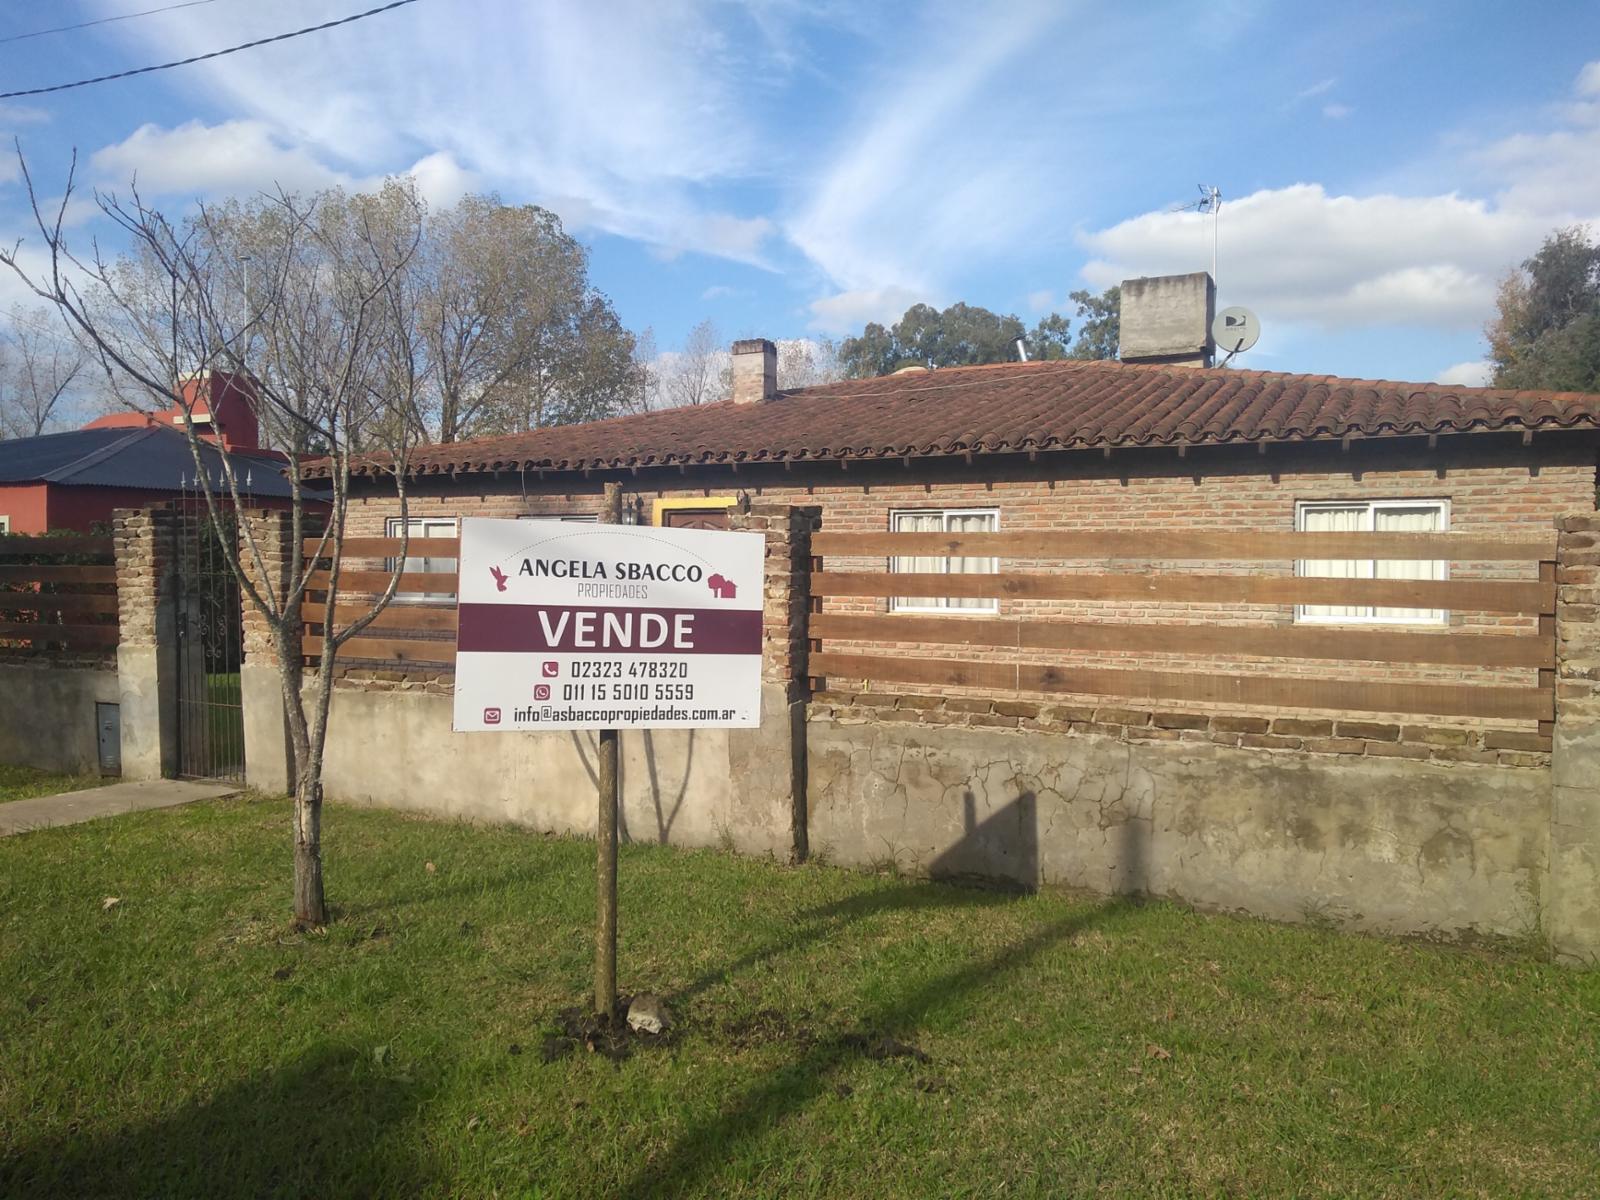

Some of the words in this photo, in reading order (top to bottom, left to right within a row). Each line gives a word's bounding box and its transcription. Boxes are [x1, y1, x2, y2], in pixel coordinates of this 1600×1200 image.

[518, 558, 608, 580] ANGELA
[614, 562, 703, 583] SBACCO
[577, 582, 649, 600] PROPIEDADES
[537, 610, 695, 649] VENDE
[570, 661, 623, 679] 02323
[628, 661, 688, 679] 478320
[563, 684, 585, 701] 011
[591, 684, 606, 701] 15
[612, 684, 649, 701] 5010
[655, 684, 694, 701] 5559
[514, 705, 736, 724] info@asbaccopropiedades.com.ar
